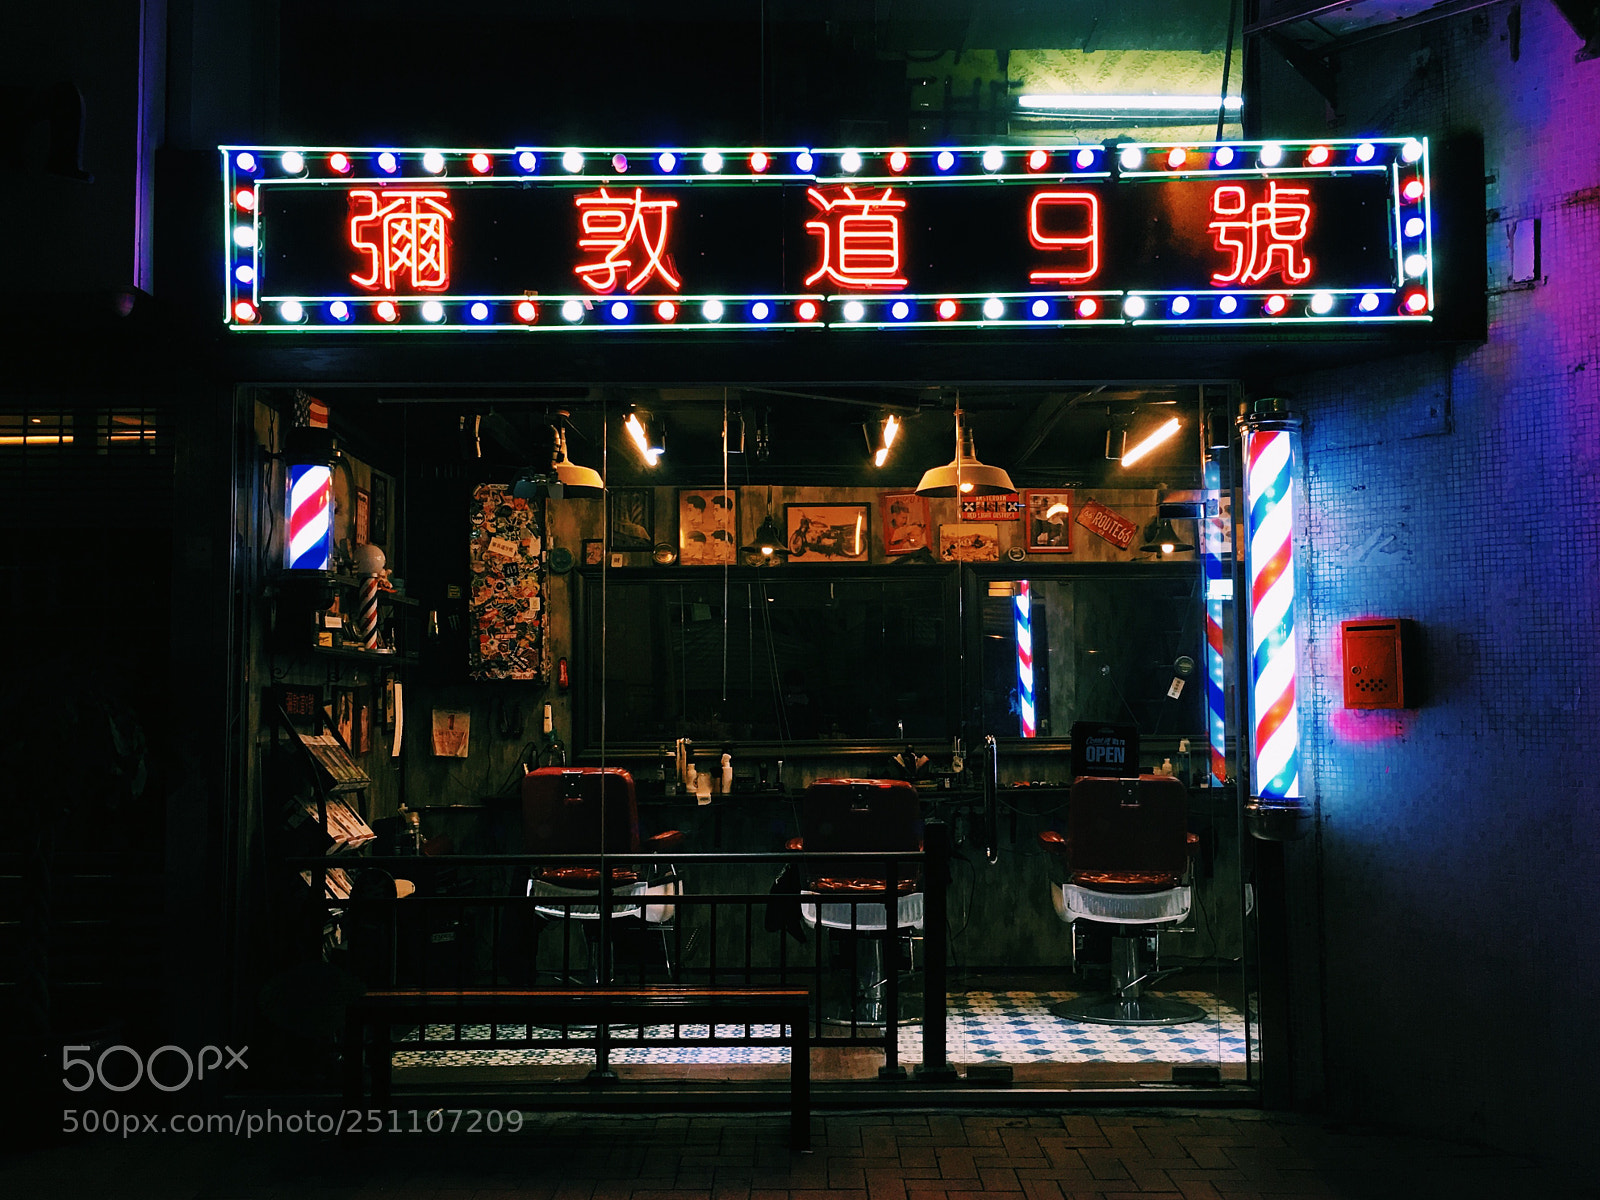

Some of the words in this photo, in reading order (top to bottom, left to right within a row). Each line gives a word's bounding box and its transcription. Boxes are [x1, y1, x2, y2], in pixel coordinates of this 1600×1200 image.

[348, 186, 1313, 292] 彌敦道9號
[1085, 745, 1125, 764] OPEN
